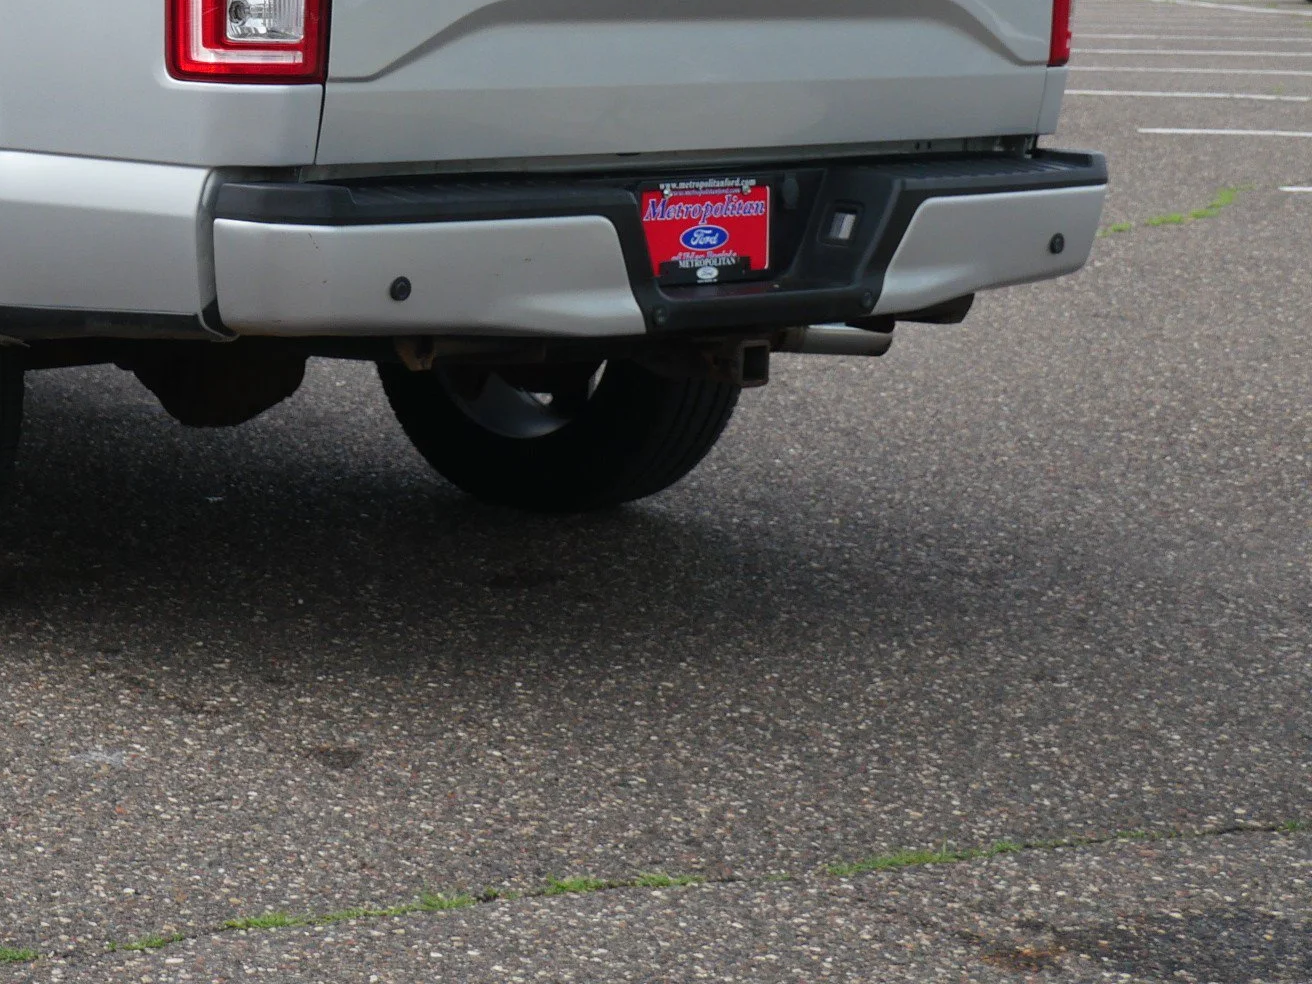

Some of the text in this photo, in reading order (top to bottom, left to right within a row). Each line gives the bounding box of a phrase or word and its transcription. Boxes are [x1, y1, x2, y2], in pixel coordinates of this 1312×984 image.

[659, 177, 756, 191] www.metropolitanford.com
[642, 194, 766, 225] Metropolitan
[690, 229, 720, 246] Ford
[678, 256, 737, 268] METROPOLITAN
